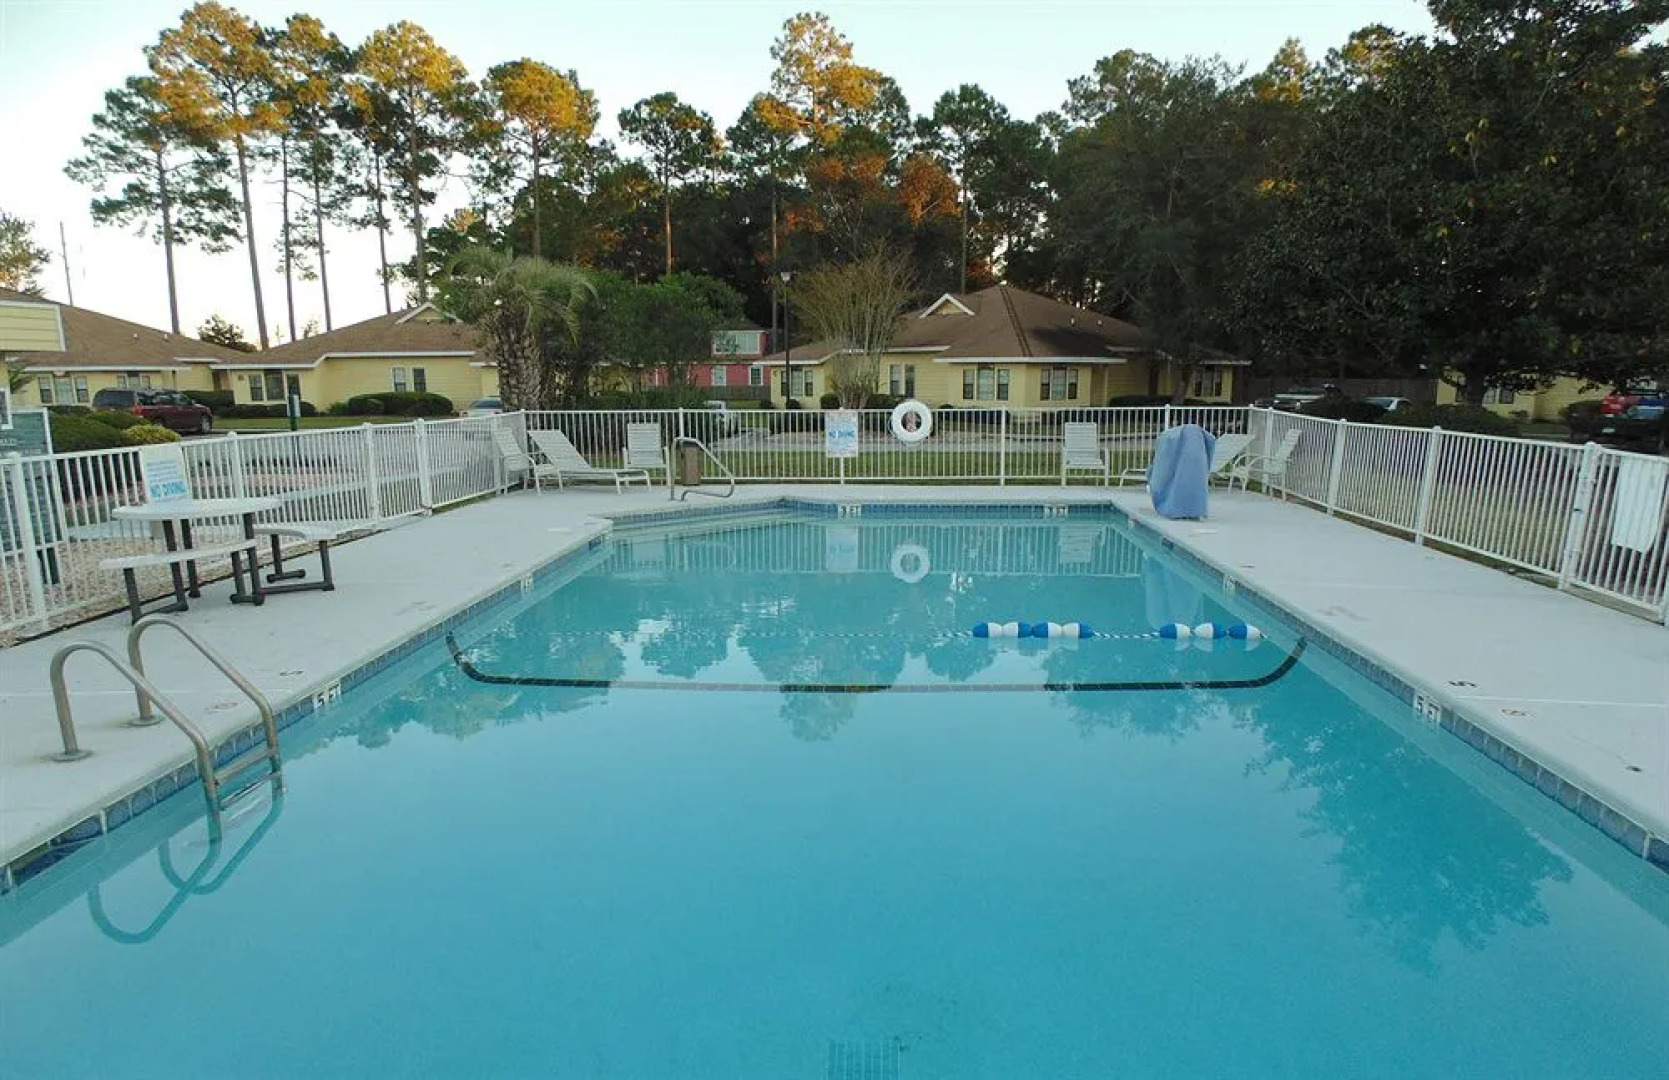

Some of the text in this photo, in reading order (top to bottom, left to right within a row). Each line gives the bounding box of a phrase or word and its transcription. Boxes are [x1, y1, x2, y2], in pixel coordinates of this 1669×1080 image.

[328, 683, 340, 702] FT
[1416, 694, 1440, 723] 5 FT
